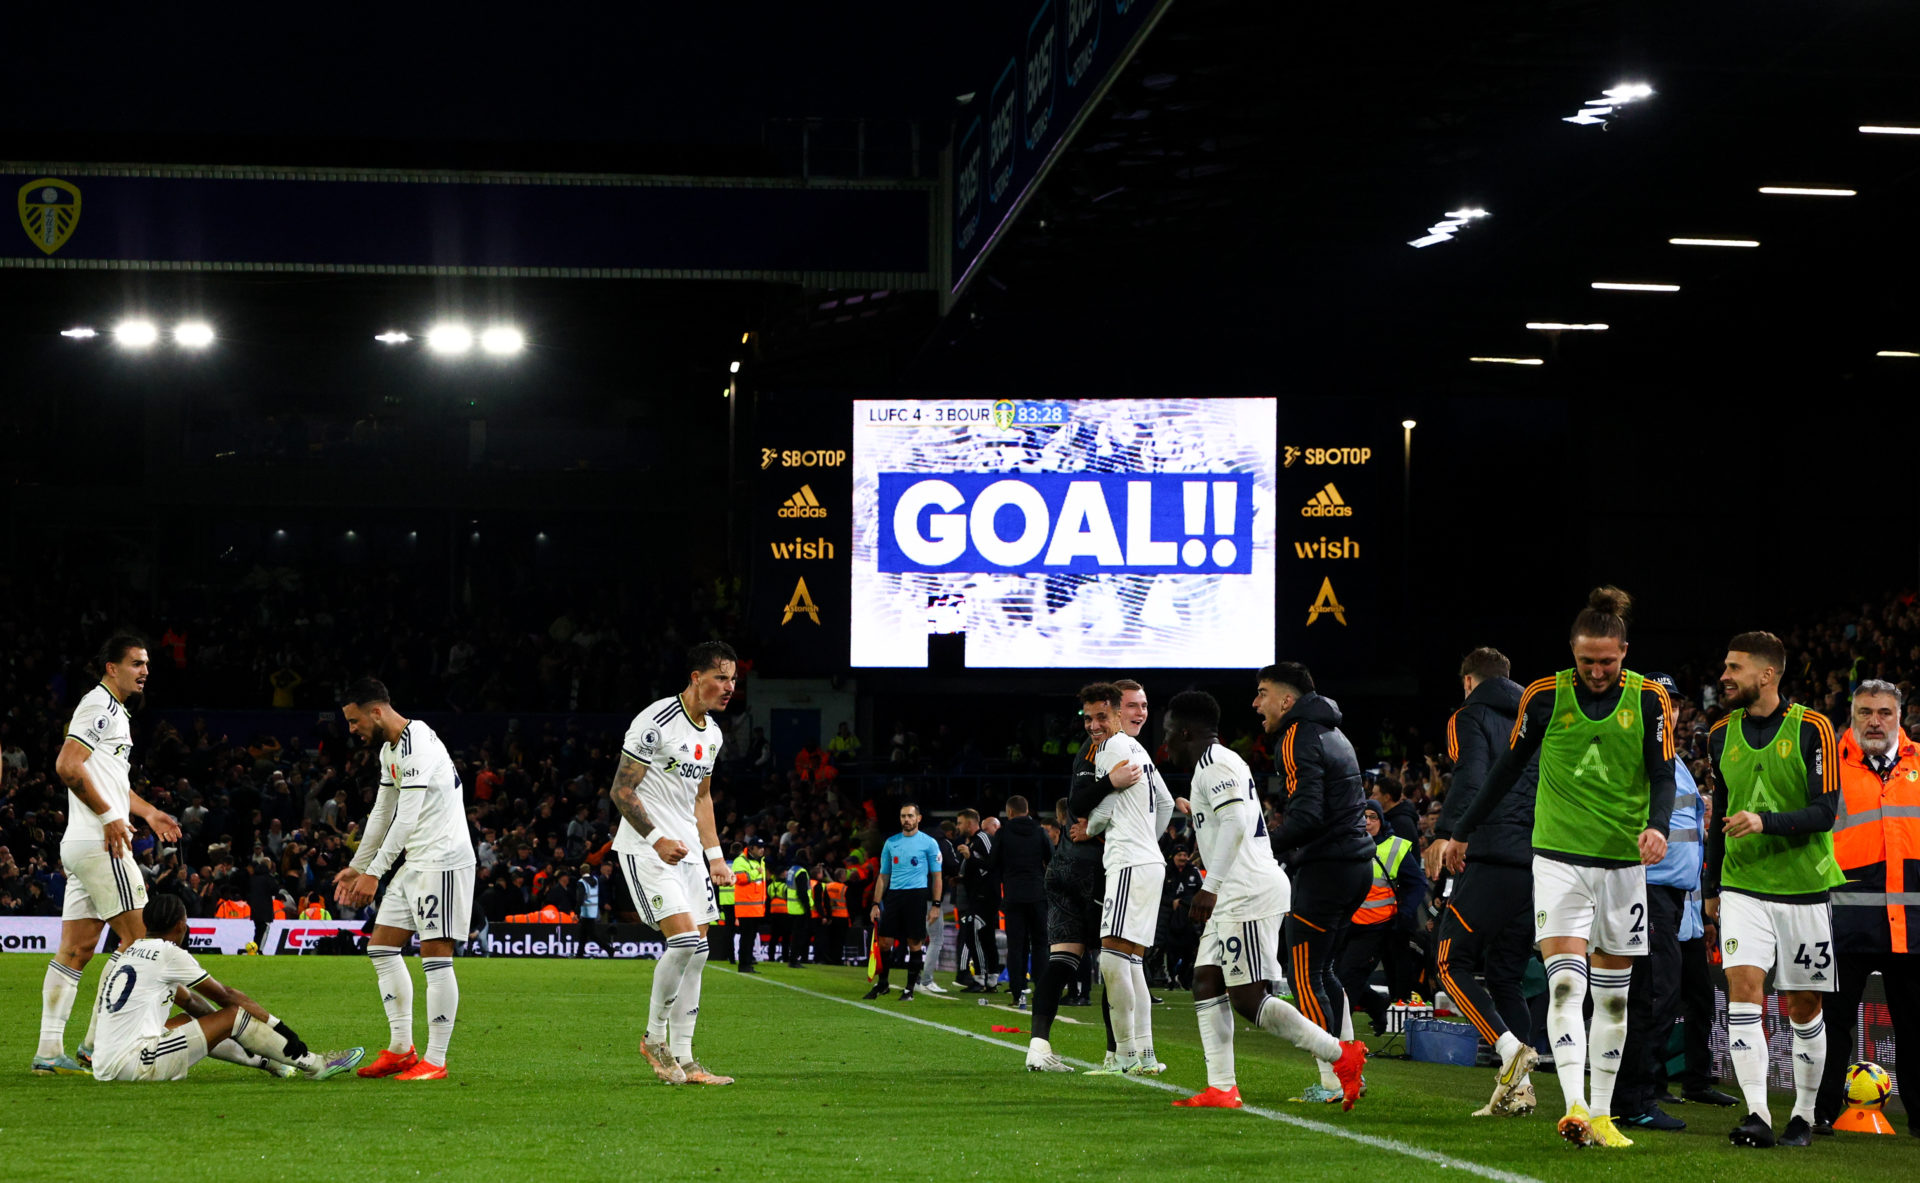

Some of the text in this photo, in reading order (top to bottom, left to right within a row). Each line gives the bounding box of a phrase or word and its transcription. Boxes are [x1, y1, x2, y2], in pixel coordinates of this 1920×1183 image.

[870, 408, 908, 422] LUFC
[912, 408, 922, 422] 4
[935, 408, 943, 422] 3
[947, 408, 990, 422] BOUR
[1018, 406, 1063, 422] 83:28
[781, 450, 846, 467] SBOTOP
[1304, 447, 1371, 465] SBOTOP
[777, 505, 828, 518] adidas
[1301, 504, 1353, 517] adidas
[893, 480, 1239, 567] GOAL!!
[771, 537, 834, 560] wish
[1294, 536, 1360, 559] wish
[401, 767, 419, 778] ish
[680, 762, 709, 780] SBOT
[416, 893, 439, 921] 42
[1629, 903, 1645, 933] 2
[0, 933, 46, 950] om
[1793, 941, 1832, 970] 43
